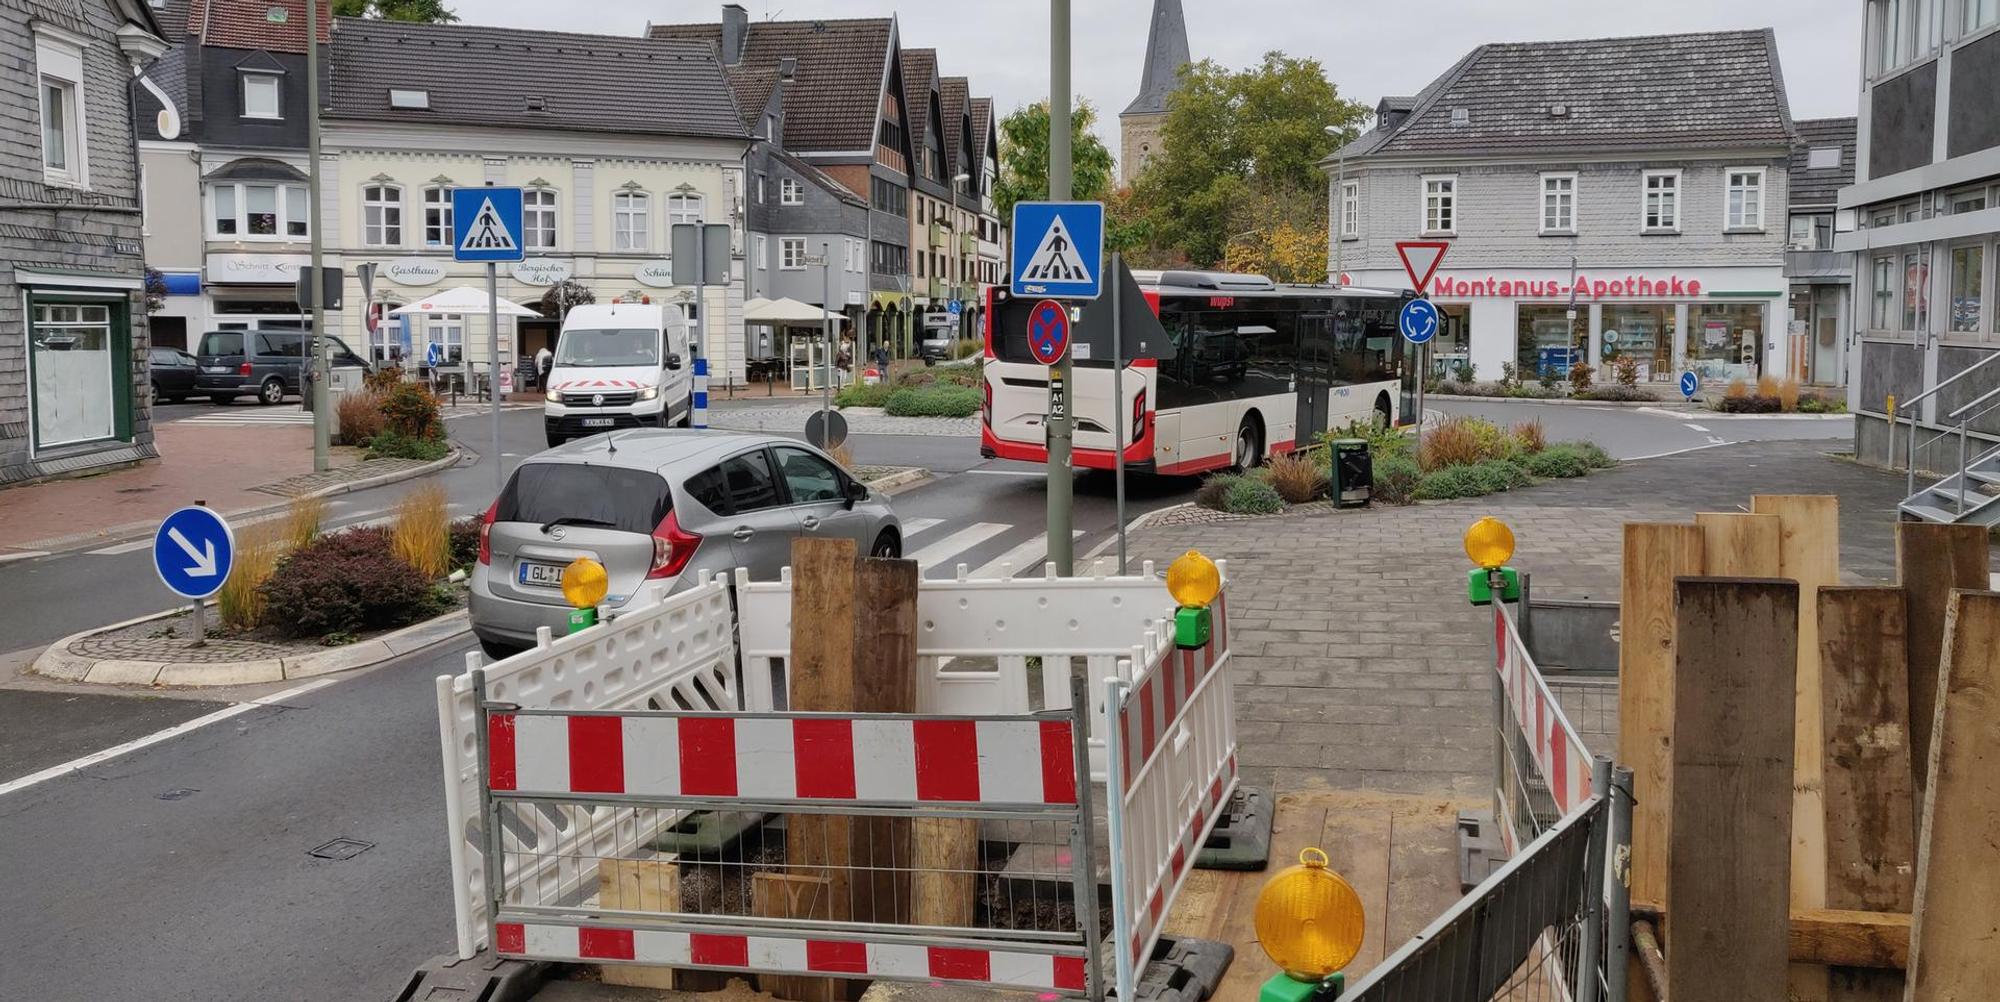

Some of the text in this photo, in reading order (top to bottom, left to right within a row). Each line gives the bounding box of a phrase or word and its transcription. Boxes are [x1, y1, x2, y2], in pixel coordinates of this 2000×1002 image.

[391, 264, 439, 276] Gasthaus
[517, 263, 564, 273] Bergischer
[643, 267, 671, 278] Schän
[532, 274, 550, 284] Hof
[1435, 275, 1701, 301] Montanus-Apotheke
[1052, 393, 1063, 402] A1
[1052, 405, 1064, 414] A2
[532, 566, 547, 580] GL
